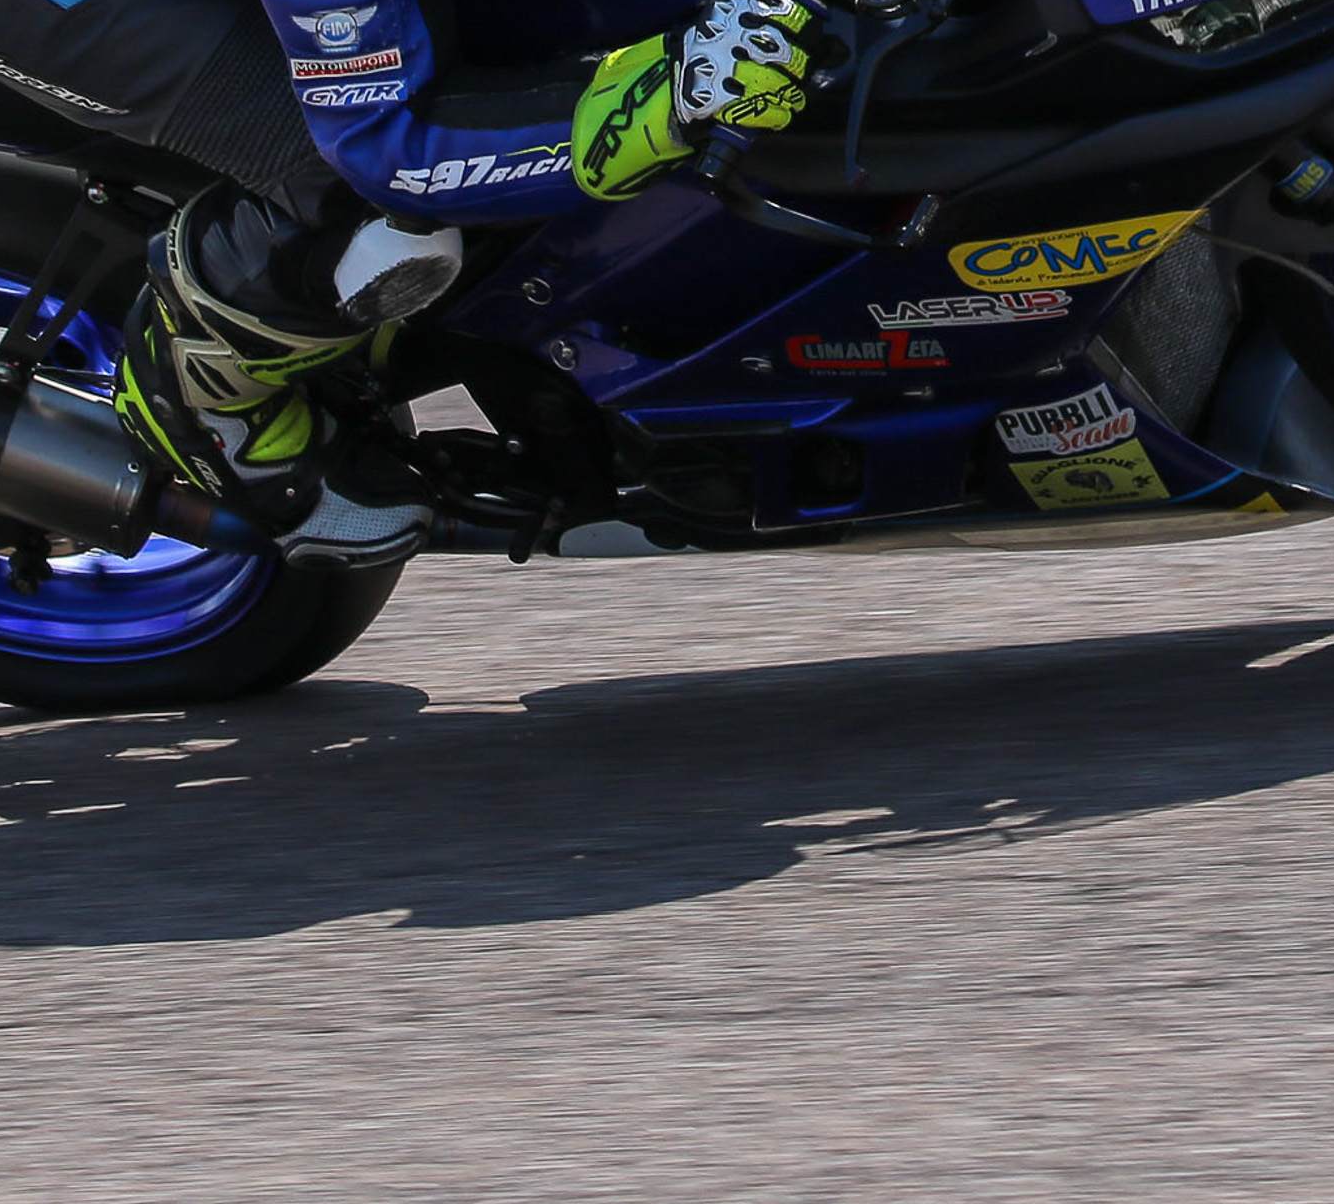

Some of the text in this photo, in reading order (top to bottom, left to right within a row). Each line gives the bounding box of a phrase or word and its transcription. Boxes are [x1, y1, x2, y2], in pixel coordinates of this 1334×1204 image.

[322, 20, 351, 37] FIM
[294, 52, 397, 73] MOTORSPORT
[302, 80, 405, 106] GYTR
[389, 153, 573, 194] S97 RACI
[869, 291, 1061, 324] LASER UP
[998, 390, 1113, 439] PUBBLI
[1030, 456, 1139, 485] GUAGLIONE
